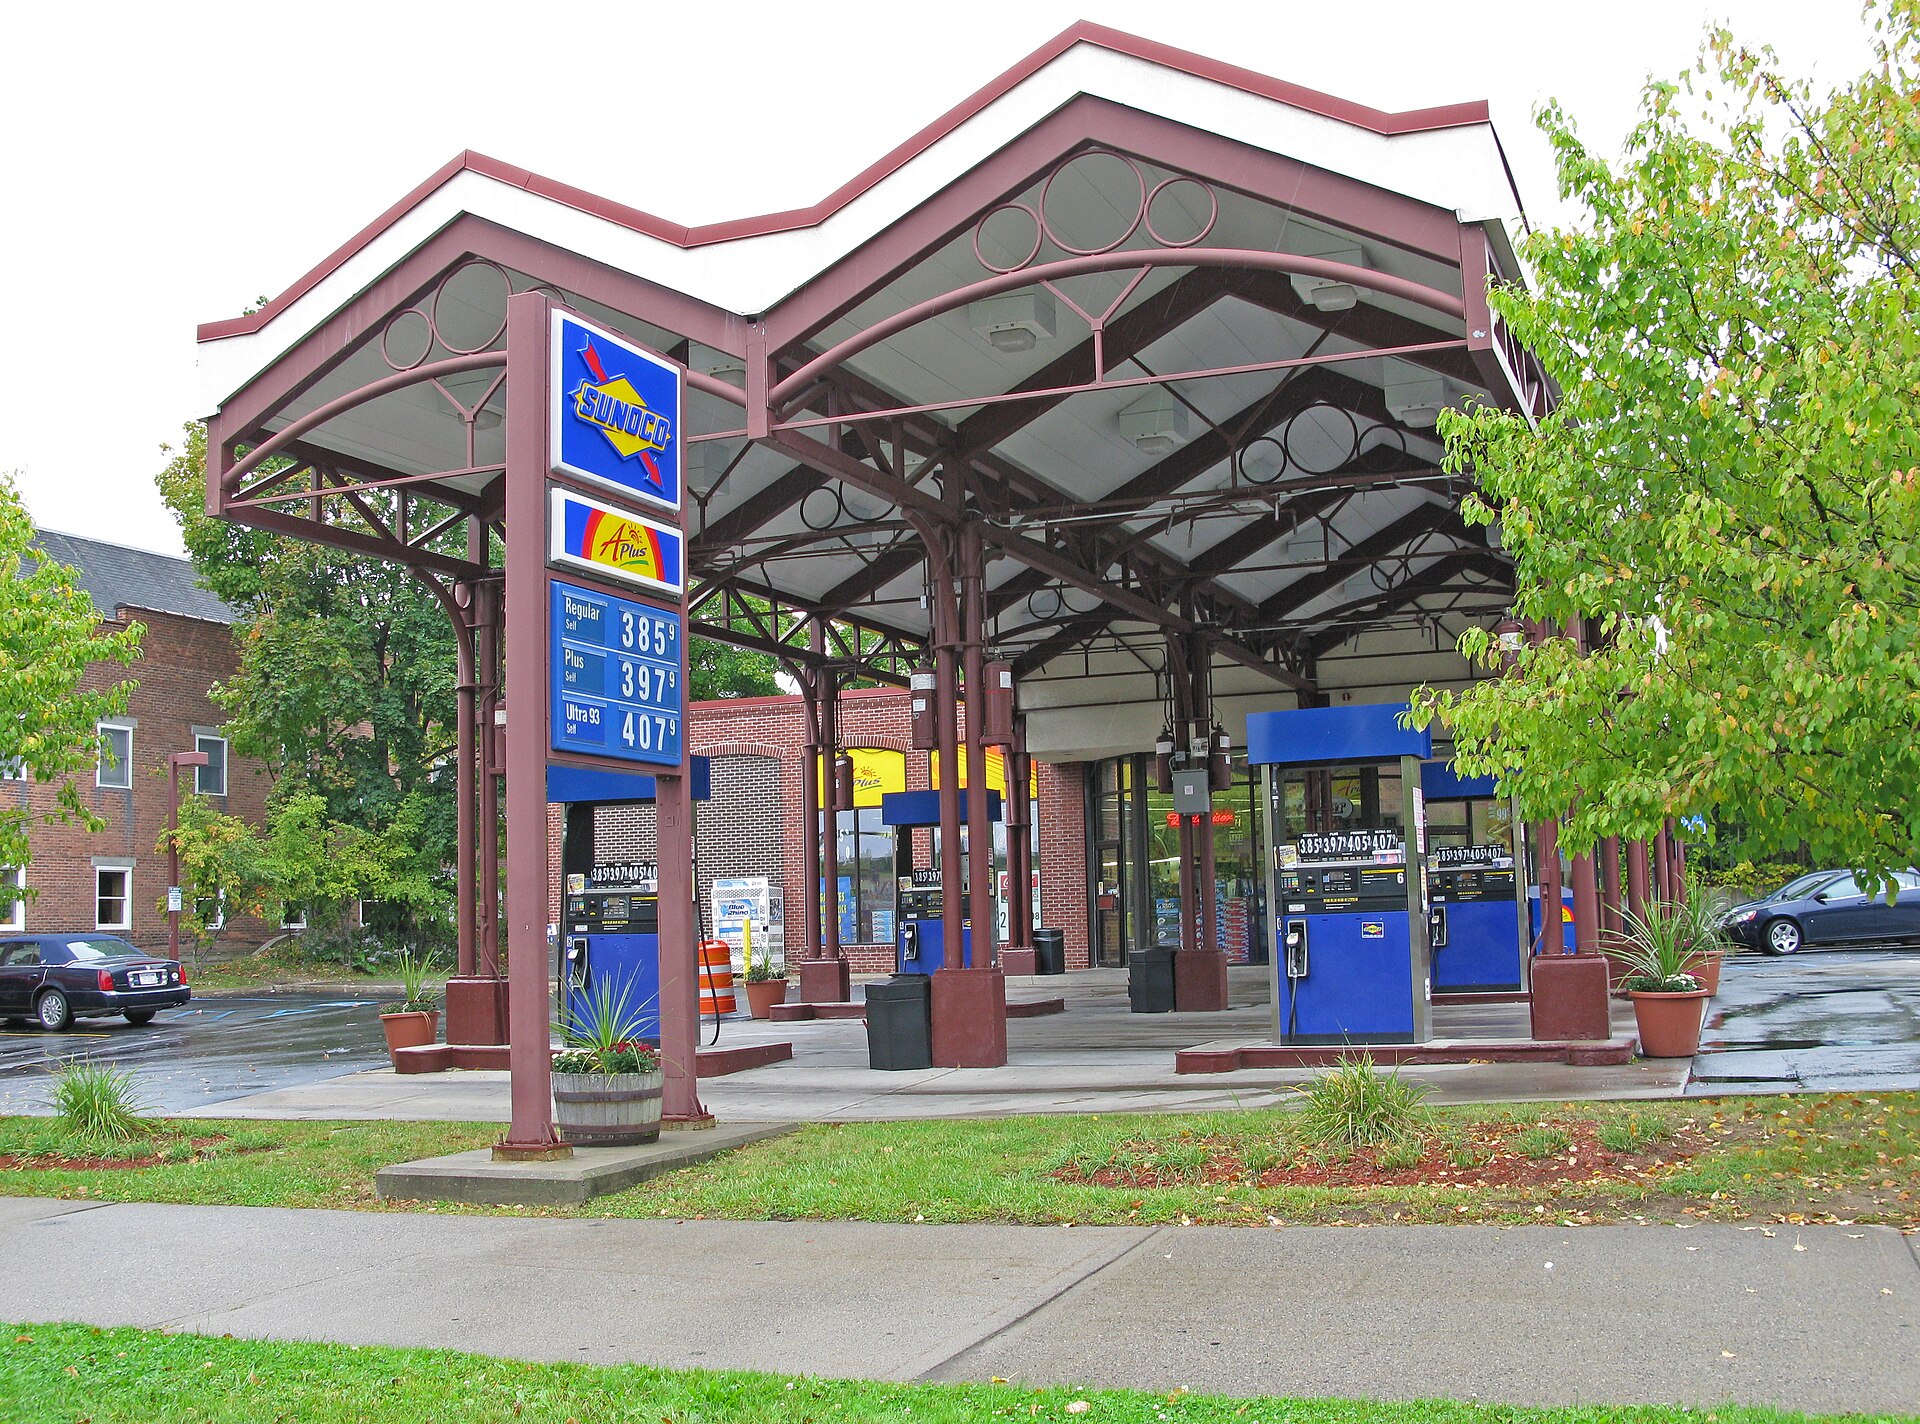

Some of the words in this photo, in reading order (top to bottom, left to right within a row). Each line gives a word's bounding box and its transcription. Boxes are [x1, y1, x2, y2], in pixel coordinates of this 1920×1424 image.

[580, 385, 670, 447] SUNOCO
[565, 597, 600, 621] Regular
[565, 619, 577, 631] Self
[565, 649, 585, 669] Plus
[565, 671, 577, 683] Self
[566, 703, 588, 723] Ultra
[589, 707, 600, 725] 93
[566, 723, 577, 735] Self
[1396, 872, 1405, 884] 6
[1508, 874, 1514, 882] 2
